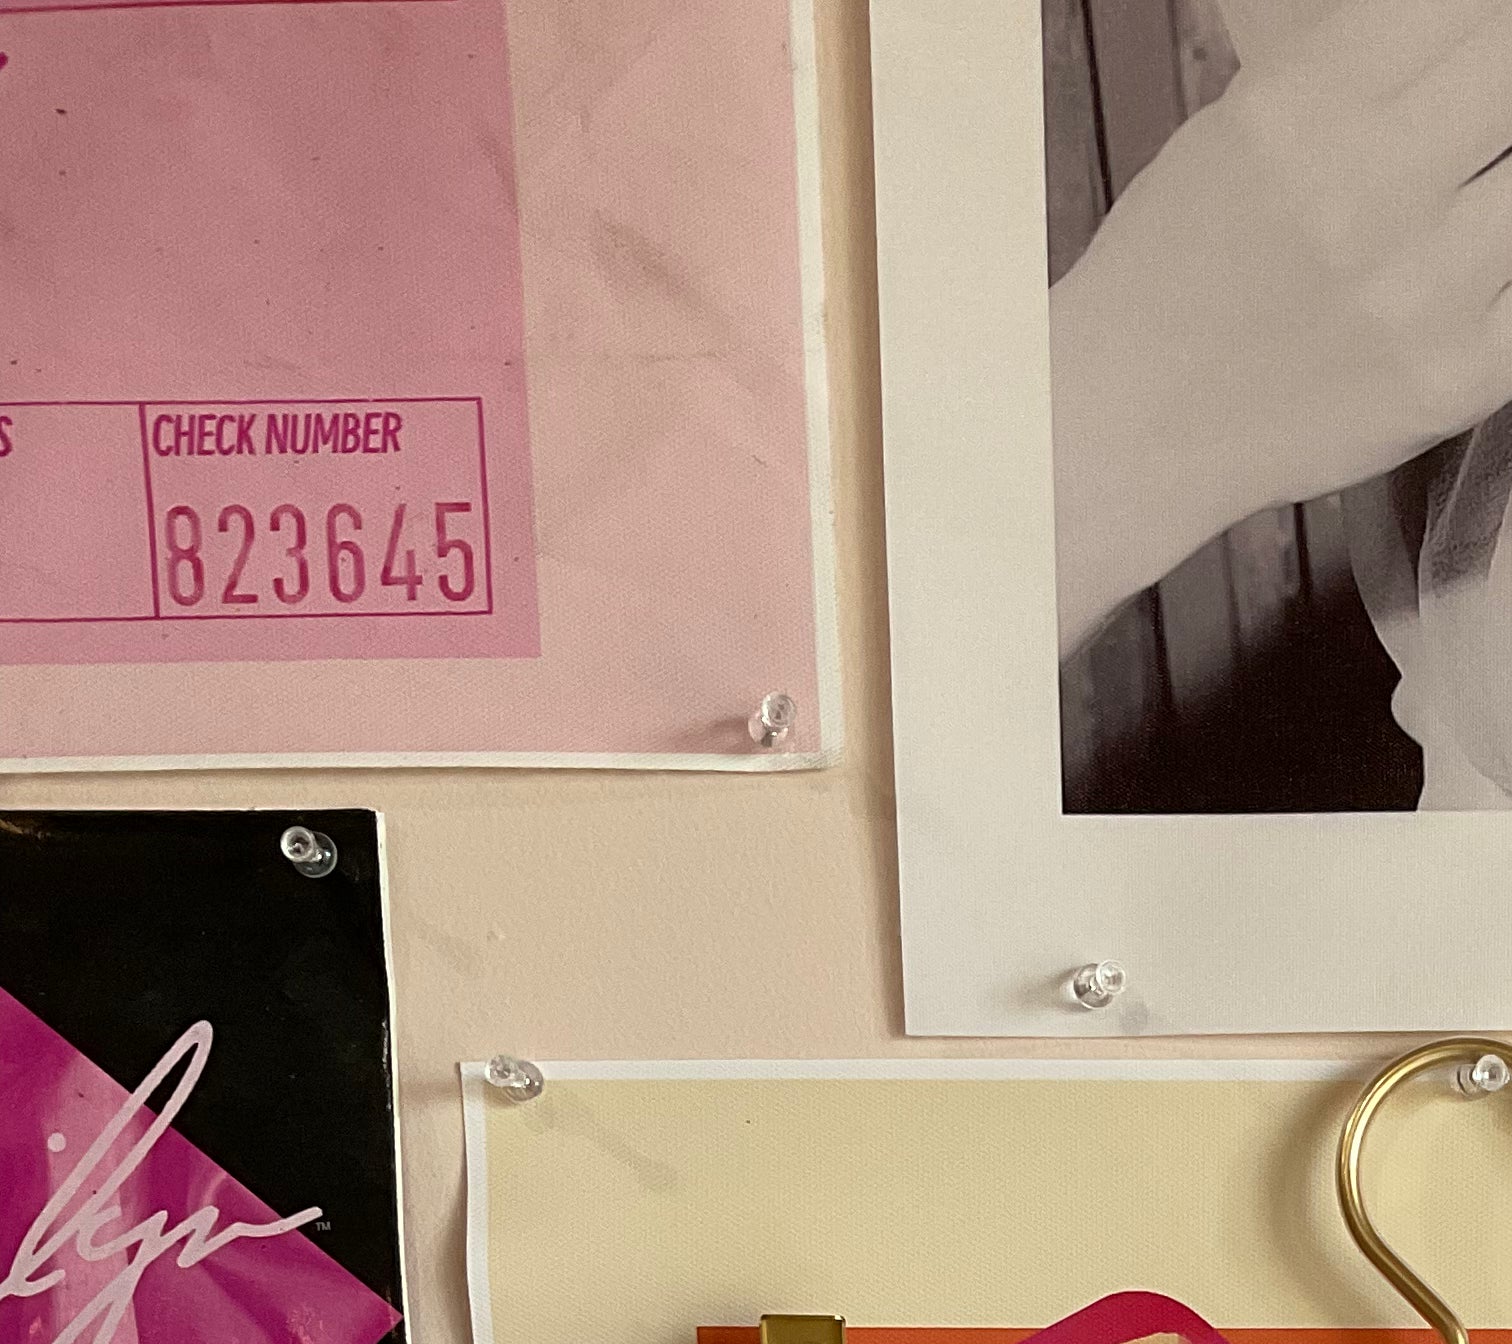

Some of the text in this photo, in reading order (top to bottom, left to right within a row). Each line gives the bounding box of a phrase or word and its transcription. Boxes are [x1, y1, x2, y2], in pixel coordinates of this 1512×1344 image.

[152, 411, 403, 457] CHECK NUMBER
[165, 502, 476, 606] 823645
